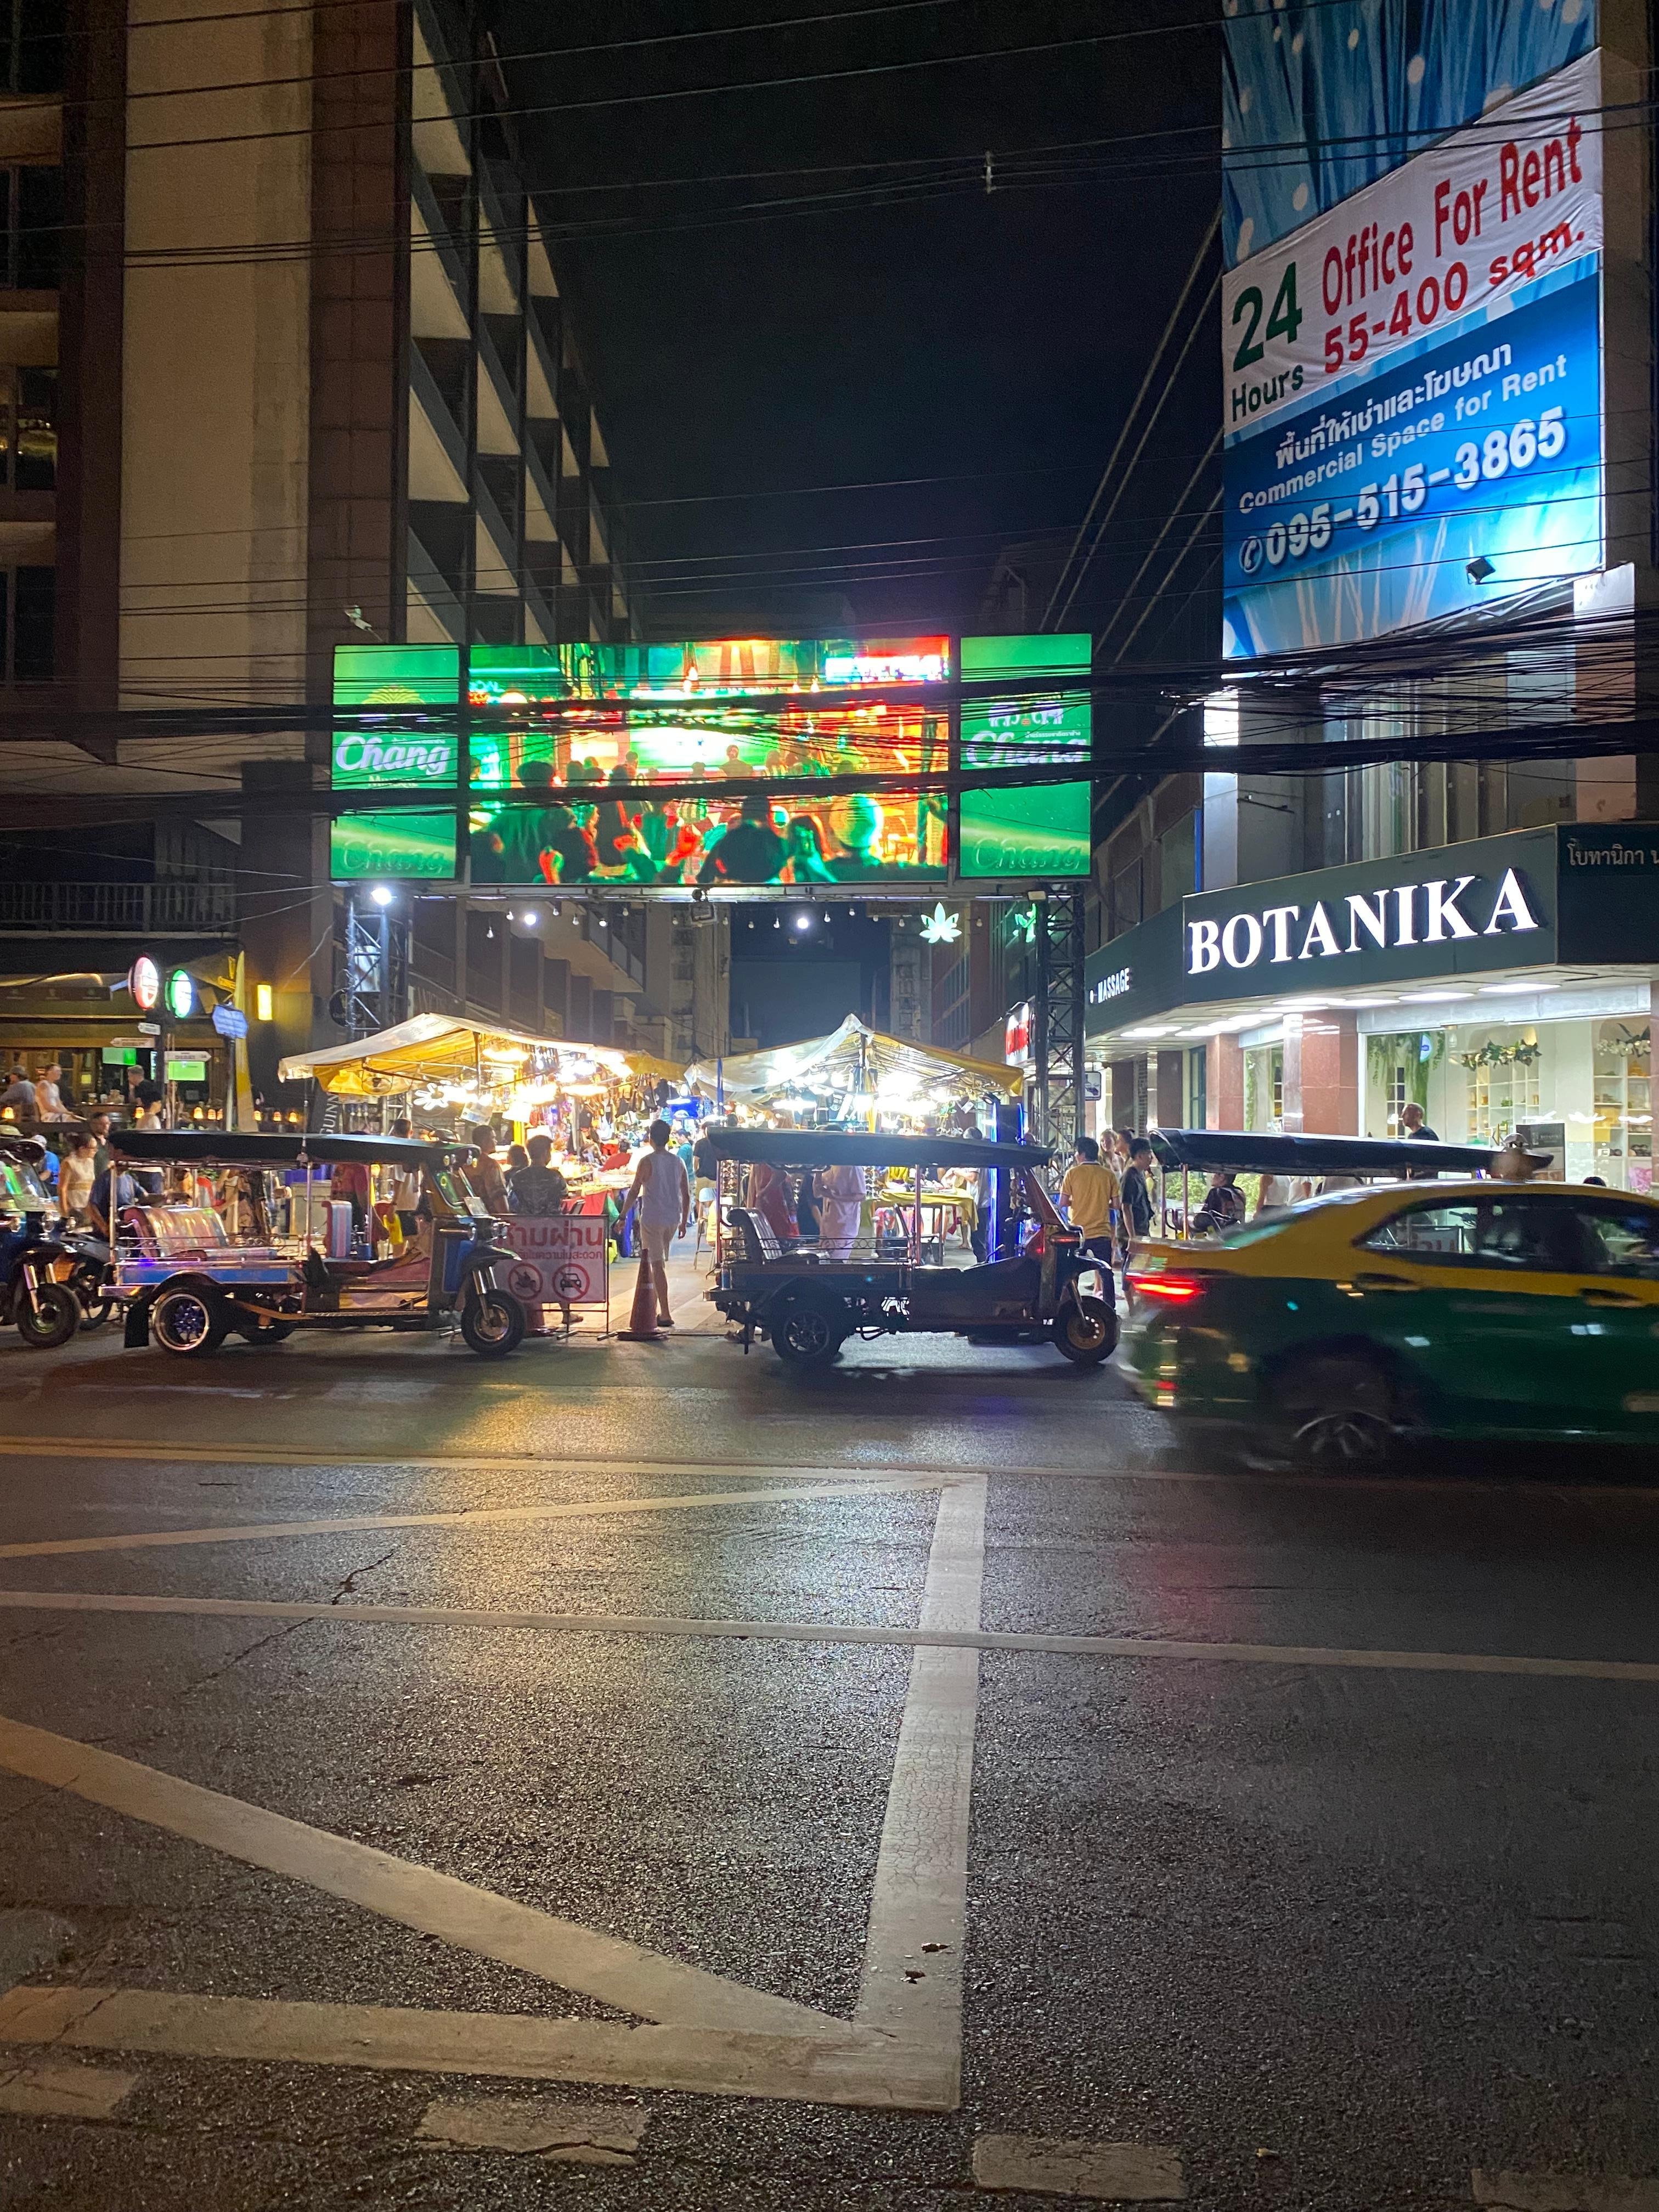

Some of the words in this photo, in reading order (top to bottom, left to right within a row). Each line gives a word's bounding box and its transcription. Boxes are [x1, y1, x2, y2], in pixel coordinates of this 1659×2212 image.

[1322, 222, 1414, 316] Office
[1435, 179, 1488, 258] For
[1500, 116, 1583, 222] Rent
[1232, 262, 1302, 373] 24
[1324, 262, 1469, 373] 55-400
[1489, 221, 1585, 285] sqm.
[1232, 365, 1304, 422] Hours
[1239, 443, 1363, 514] Commercial
[1372, 413, 1445, 458] Space
[1455, 390, 1492, 421] for
[1502, 354, 1567, 402] Rent
[1276, 343, 1512, 470] พื้นที่ให้เช่าและโฆษณา
[1265, 405, 1566, 566] 095-515-3865
[336, 736, 451, 776] Chang
[340, 839, 445, 874] Chang
[973, 838, 1082, 872] Chang
[1567, 837, 1645, 866] โบทานิกา
[1187, 867, 1538, 974] BOTANIKA
[1098, 967, 1130, 1003] MASSAGE
[319, 1093, 339, 1134] GUINN
